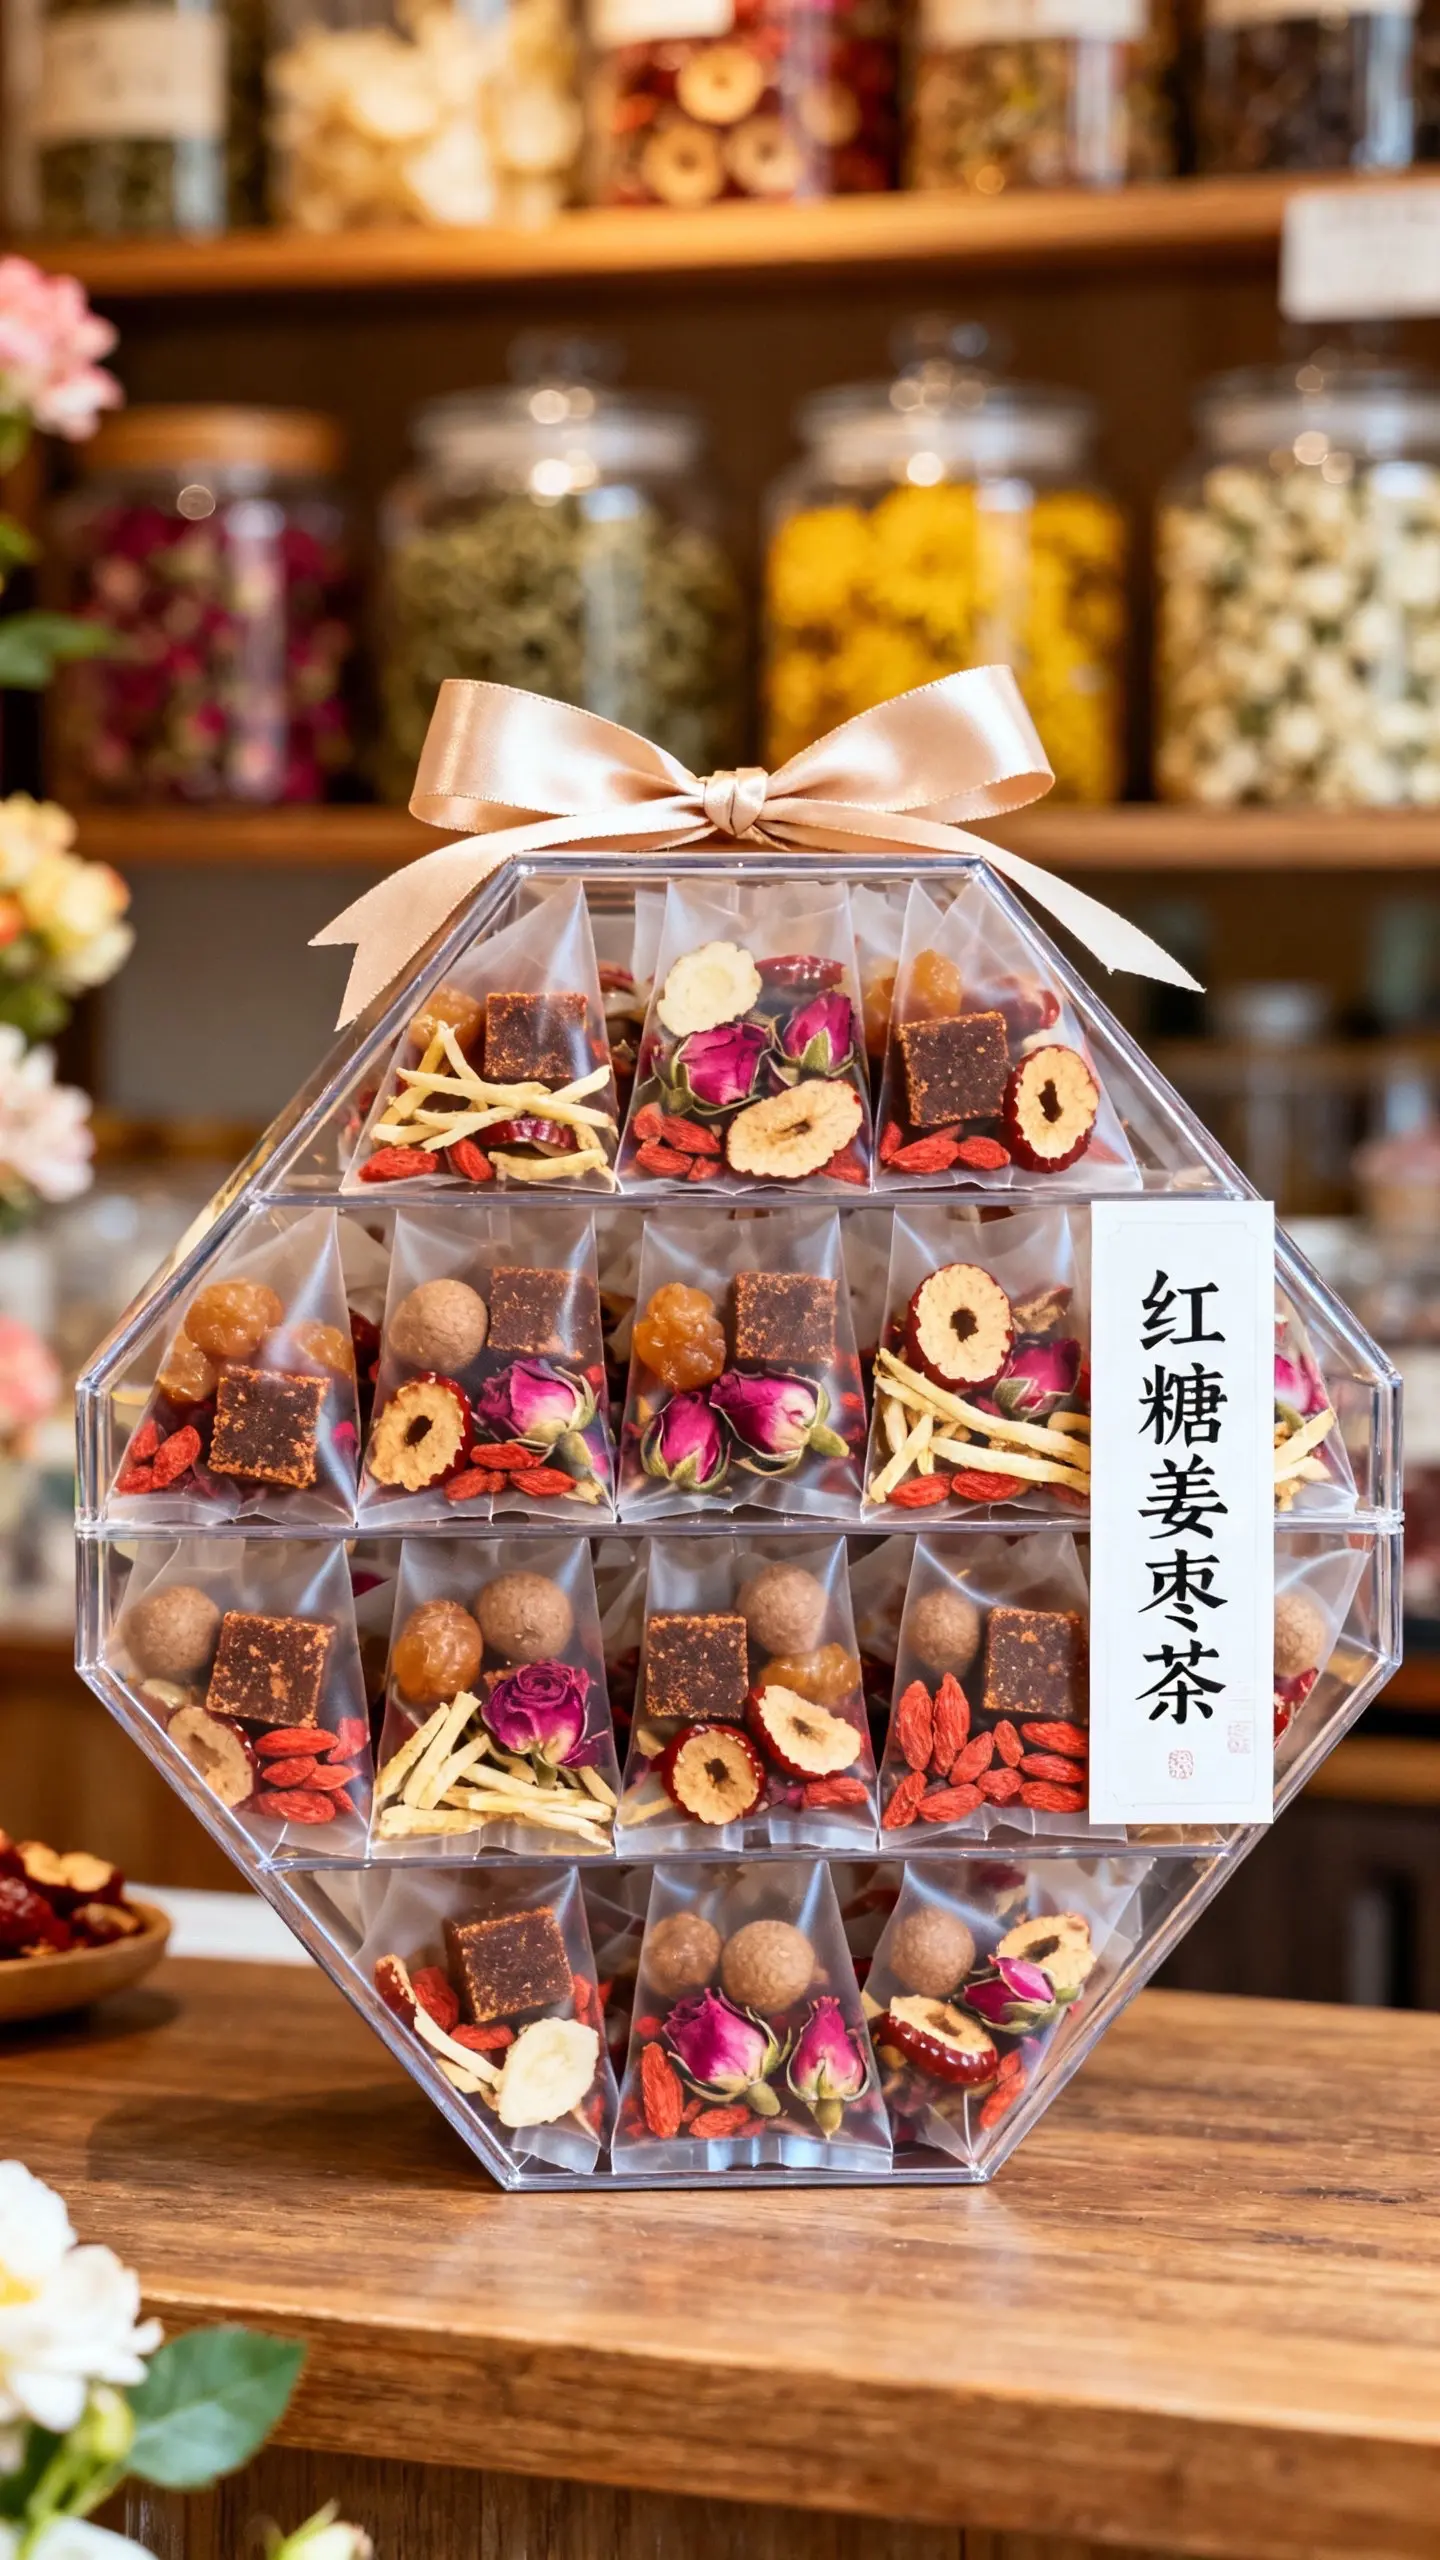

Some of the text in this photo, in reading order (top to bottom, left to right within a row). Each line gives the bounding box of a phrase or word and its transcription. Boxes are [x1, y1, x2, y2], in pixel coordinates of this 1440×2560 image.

[1135, 1269, 1229, 1725] 红糖姜枣茶
